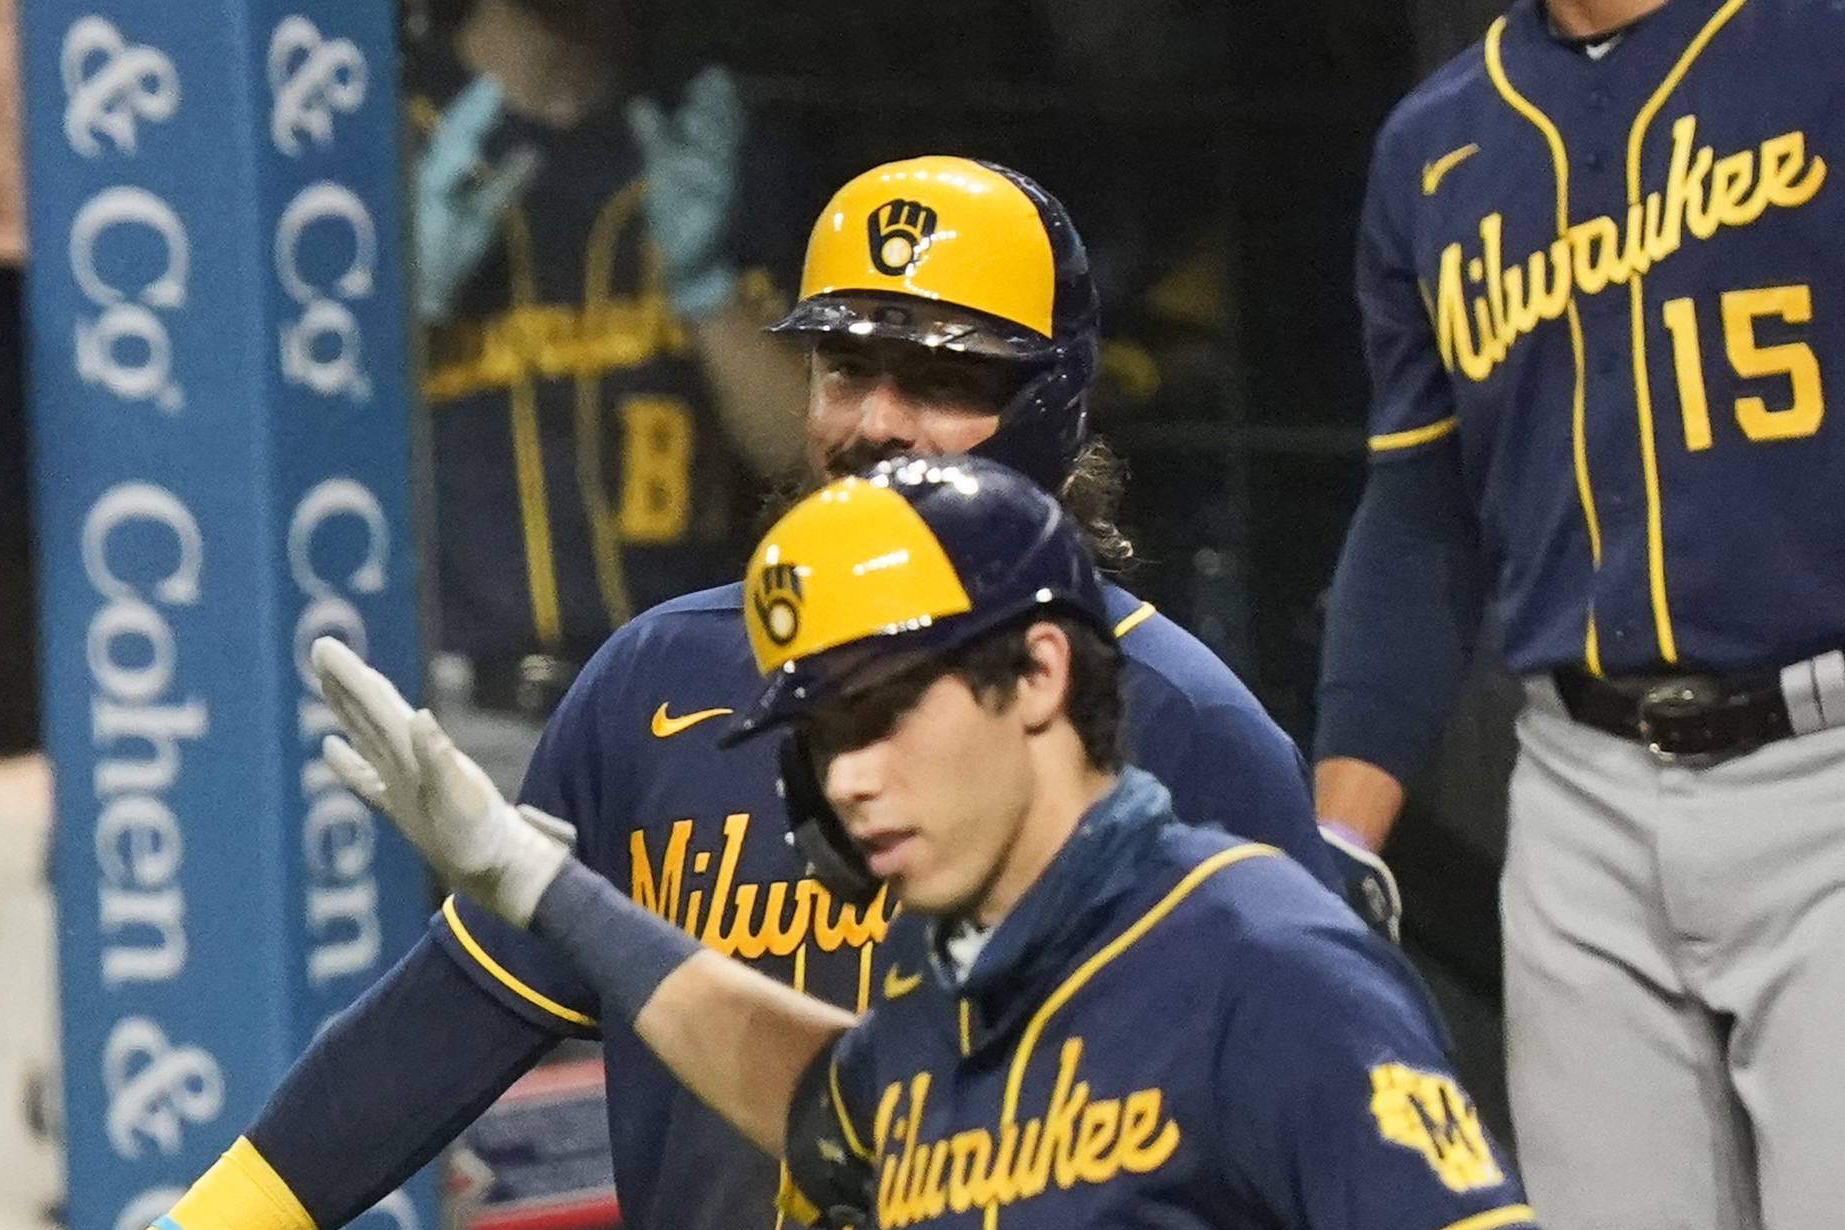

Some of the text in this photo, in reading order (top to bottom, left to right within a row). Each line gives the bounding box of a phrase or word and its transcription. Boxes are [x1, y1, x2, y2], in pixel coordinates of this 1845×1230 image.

[61, 14, 181, 160] &
[268, 14, 369, 160] &
[1431, 115, 1826, 381] Milwaukee
[1664, 285, 1824, 451] 15
[83, 480, 210, 988] Cohen
[103, 1017, 226, 1160] &
